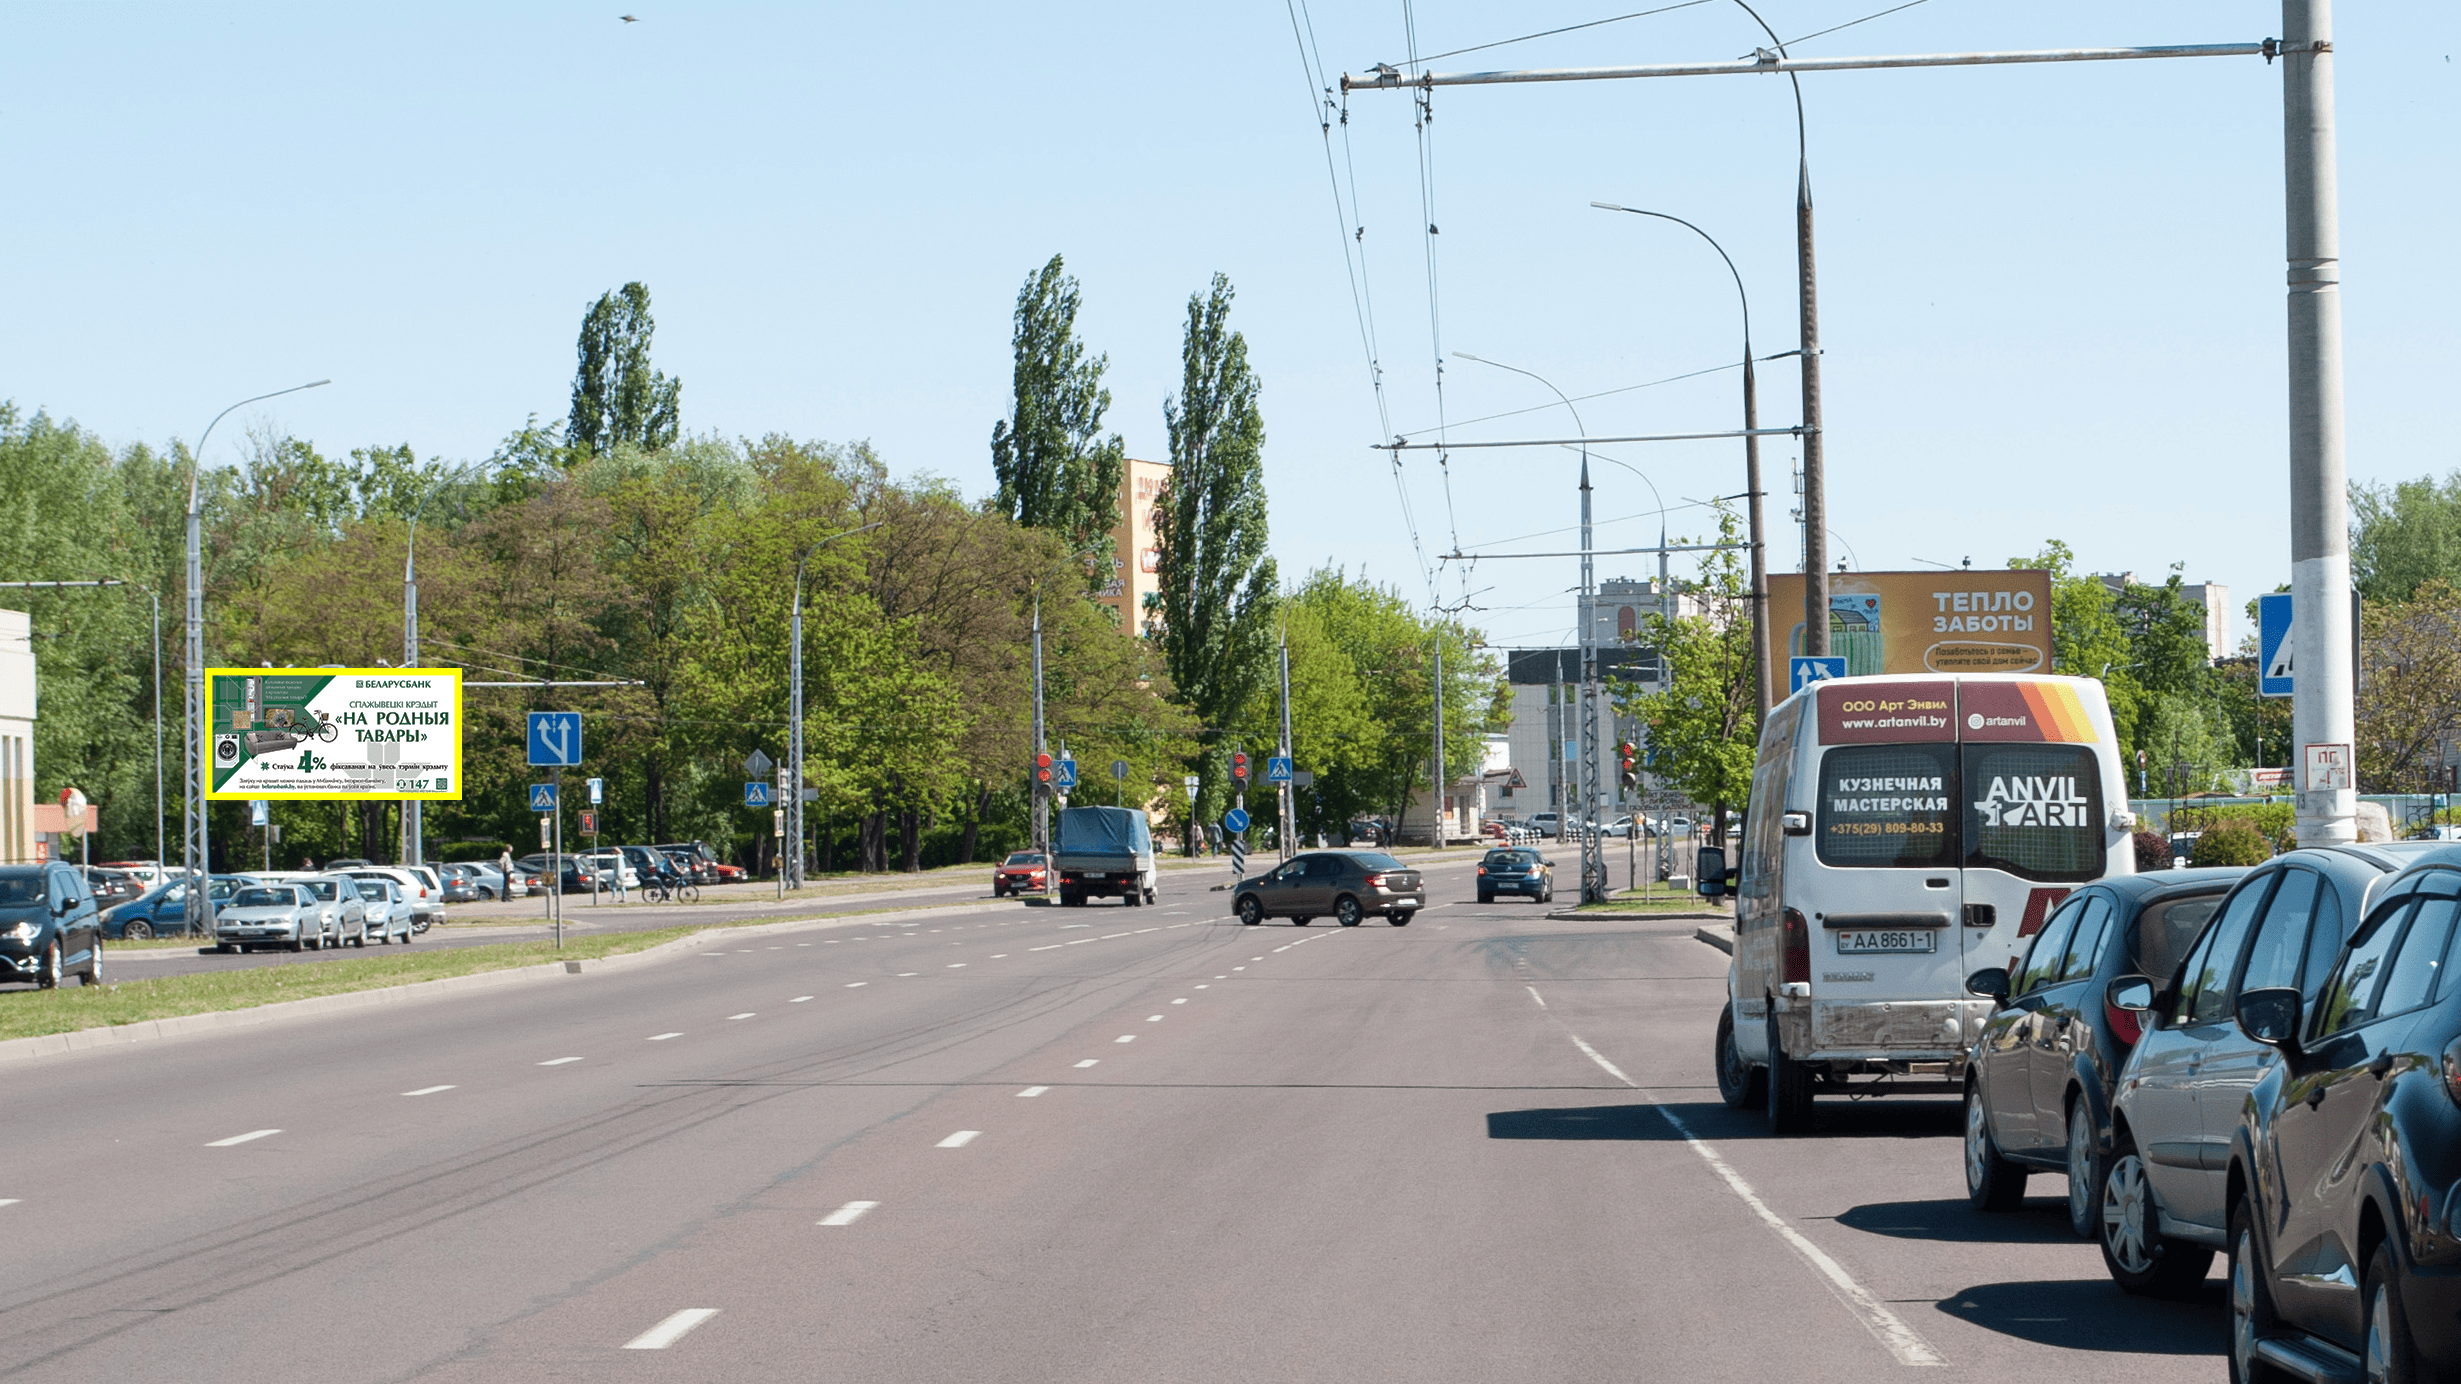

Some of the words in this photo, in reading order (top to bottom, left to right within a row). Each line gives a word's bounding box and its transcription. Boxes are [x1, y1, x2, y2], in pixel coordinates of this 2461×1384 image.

[1932, 591, 2034, 612] ТЕПЛО
[1933, 615, 2033, 632] ЗАБОТЫ
[365, 680, 431, 688] БЕЛАРУСБАНК
[349, 701, 404, 709] СПАЖЫВЕЦКІ
[406, 701, 439, 709] КРЭДЫТ
[1842, 701, 1875, 712] ООО
[1878, 700, 1904, 713] Арт
[1907, 699, 1948, 711] Энвил
[335, 711, 368, 725] «НА
[376, 711, 449, 725] РОДНЫЯ
[1842, 715, 1947, 729] www.artanvil.by
[1986, 716, 2026, 727] artanvil
[355, 729, 428, 742] ТАВАРЫ»
[297, 750, 327, 773] 4%
[408, 779, 430, 789] 147
[1838, 777, 1943, 792] КУЗНЕЧНАЯ
[1987, 776, 2087, 803] ANVIL
[1834, 798, 1948, 812] МАСТЕРСКАЯ
[2020, 802, 2087, 827] ART
[1830, 822, 1882, 836] +375(29)
